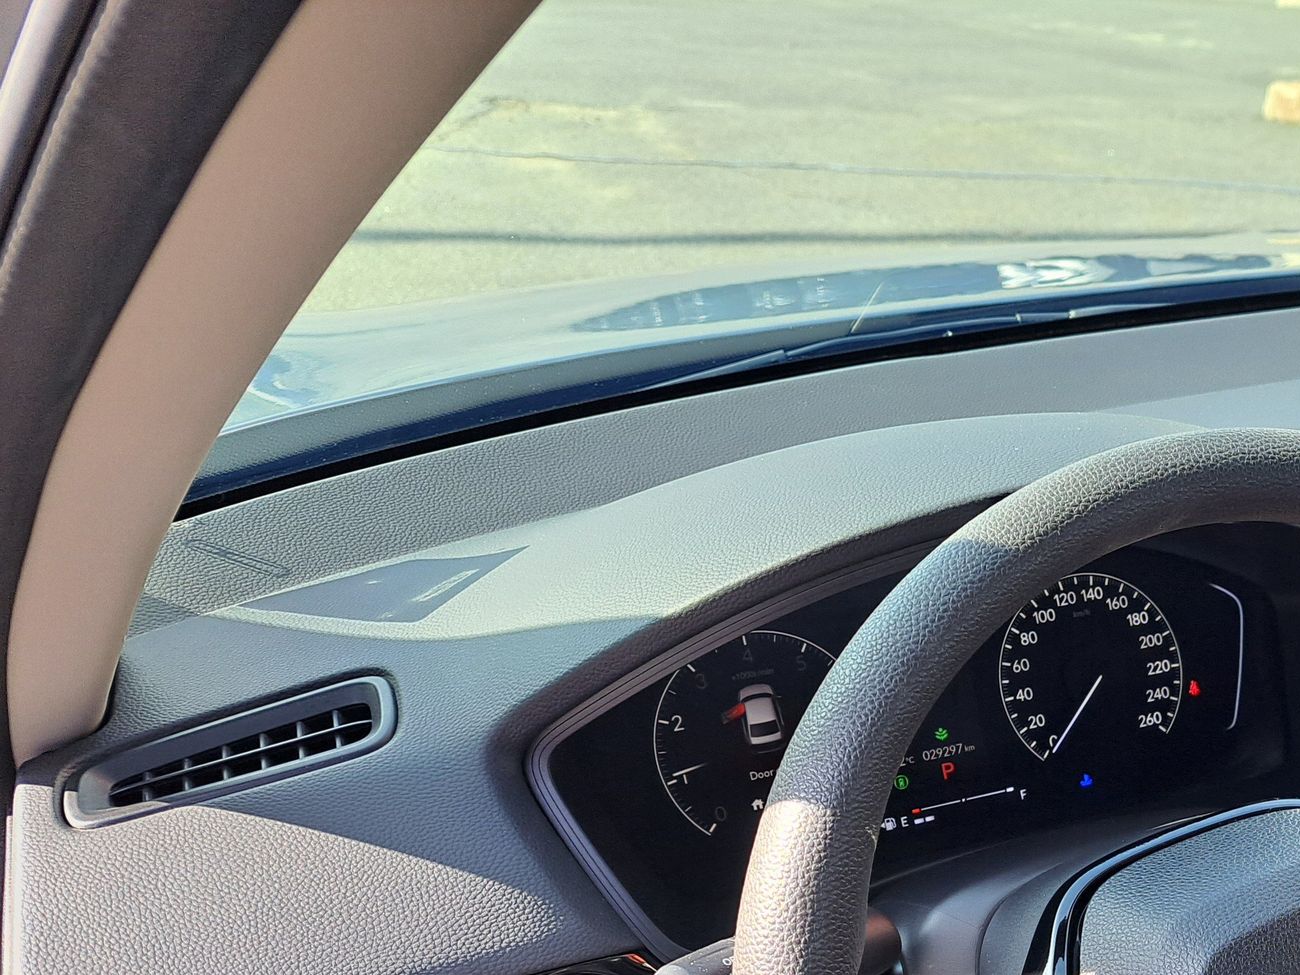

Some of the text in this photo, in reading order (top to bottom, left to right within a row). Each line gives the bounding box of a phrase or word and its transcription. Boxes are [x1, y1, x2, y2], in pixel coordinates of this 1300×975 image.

[1053, 591, 1077, 607] 120
[1080, 586, 1103, 602] 140
[1106, 595, 1128, 611] 160
[1032, 609, 1056, 624] 100
[1126, 611, 1149, 627] 180
[1020, 631, 1038, 646] 80
[1138, 634, 1163, 650] 200
[1012, 658, 1030, 673] 60
[1146, 659, 1171, 676] 220
[1016, 687, 1033, 702] 40
[1146, 686, 1170, 703] 240
[671, 715, 685, 732] 2
[1027, 714, 1046, 730] 20
[1138, 711, 1162, 728] 260
[922, 743, 976, 761] 029297 km
[750, 769, 773, 781] Door
[941, 762, 955, 780] P
[1019, 788, 1028, 800] F
[900, 816, 909, 827] E
